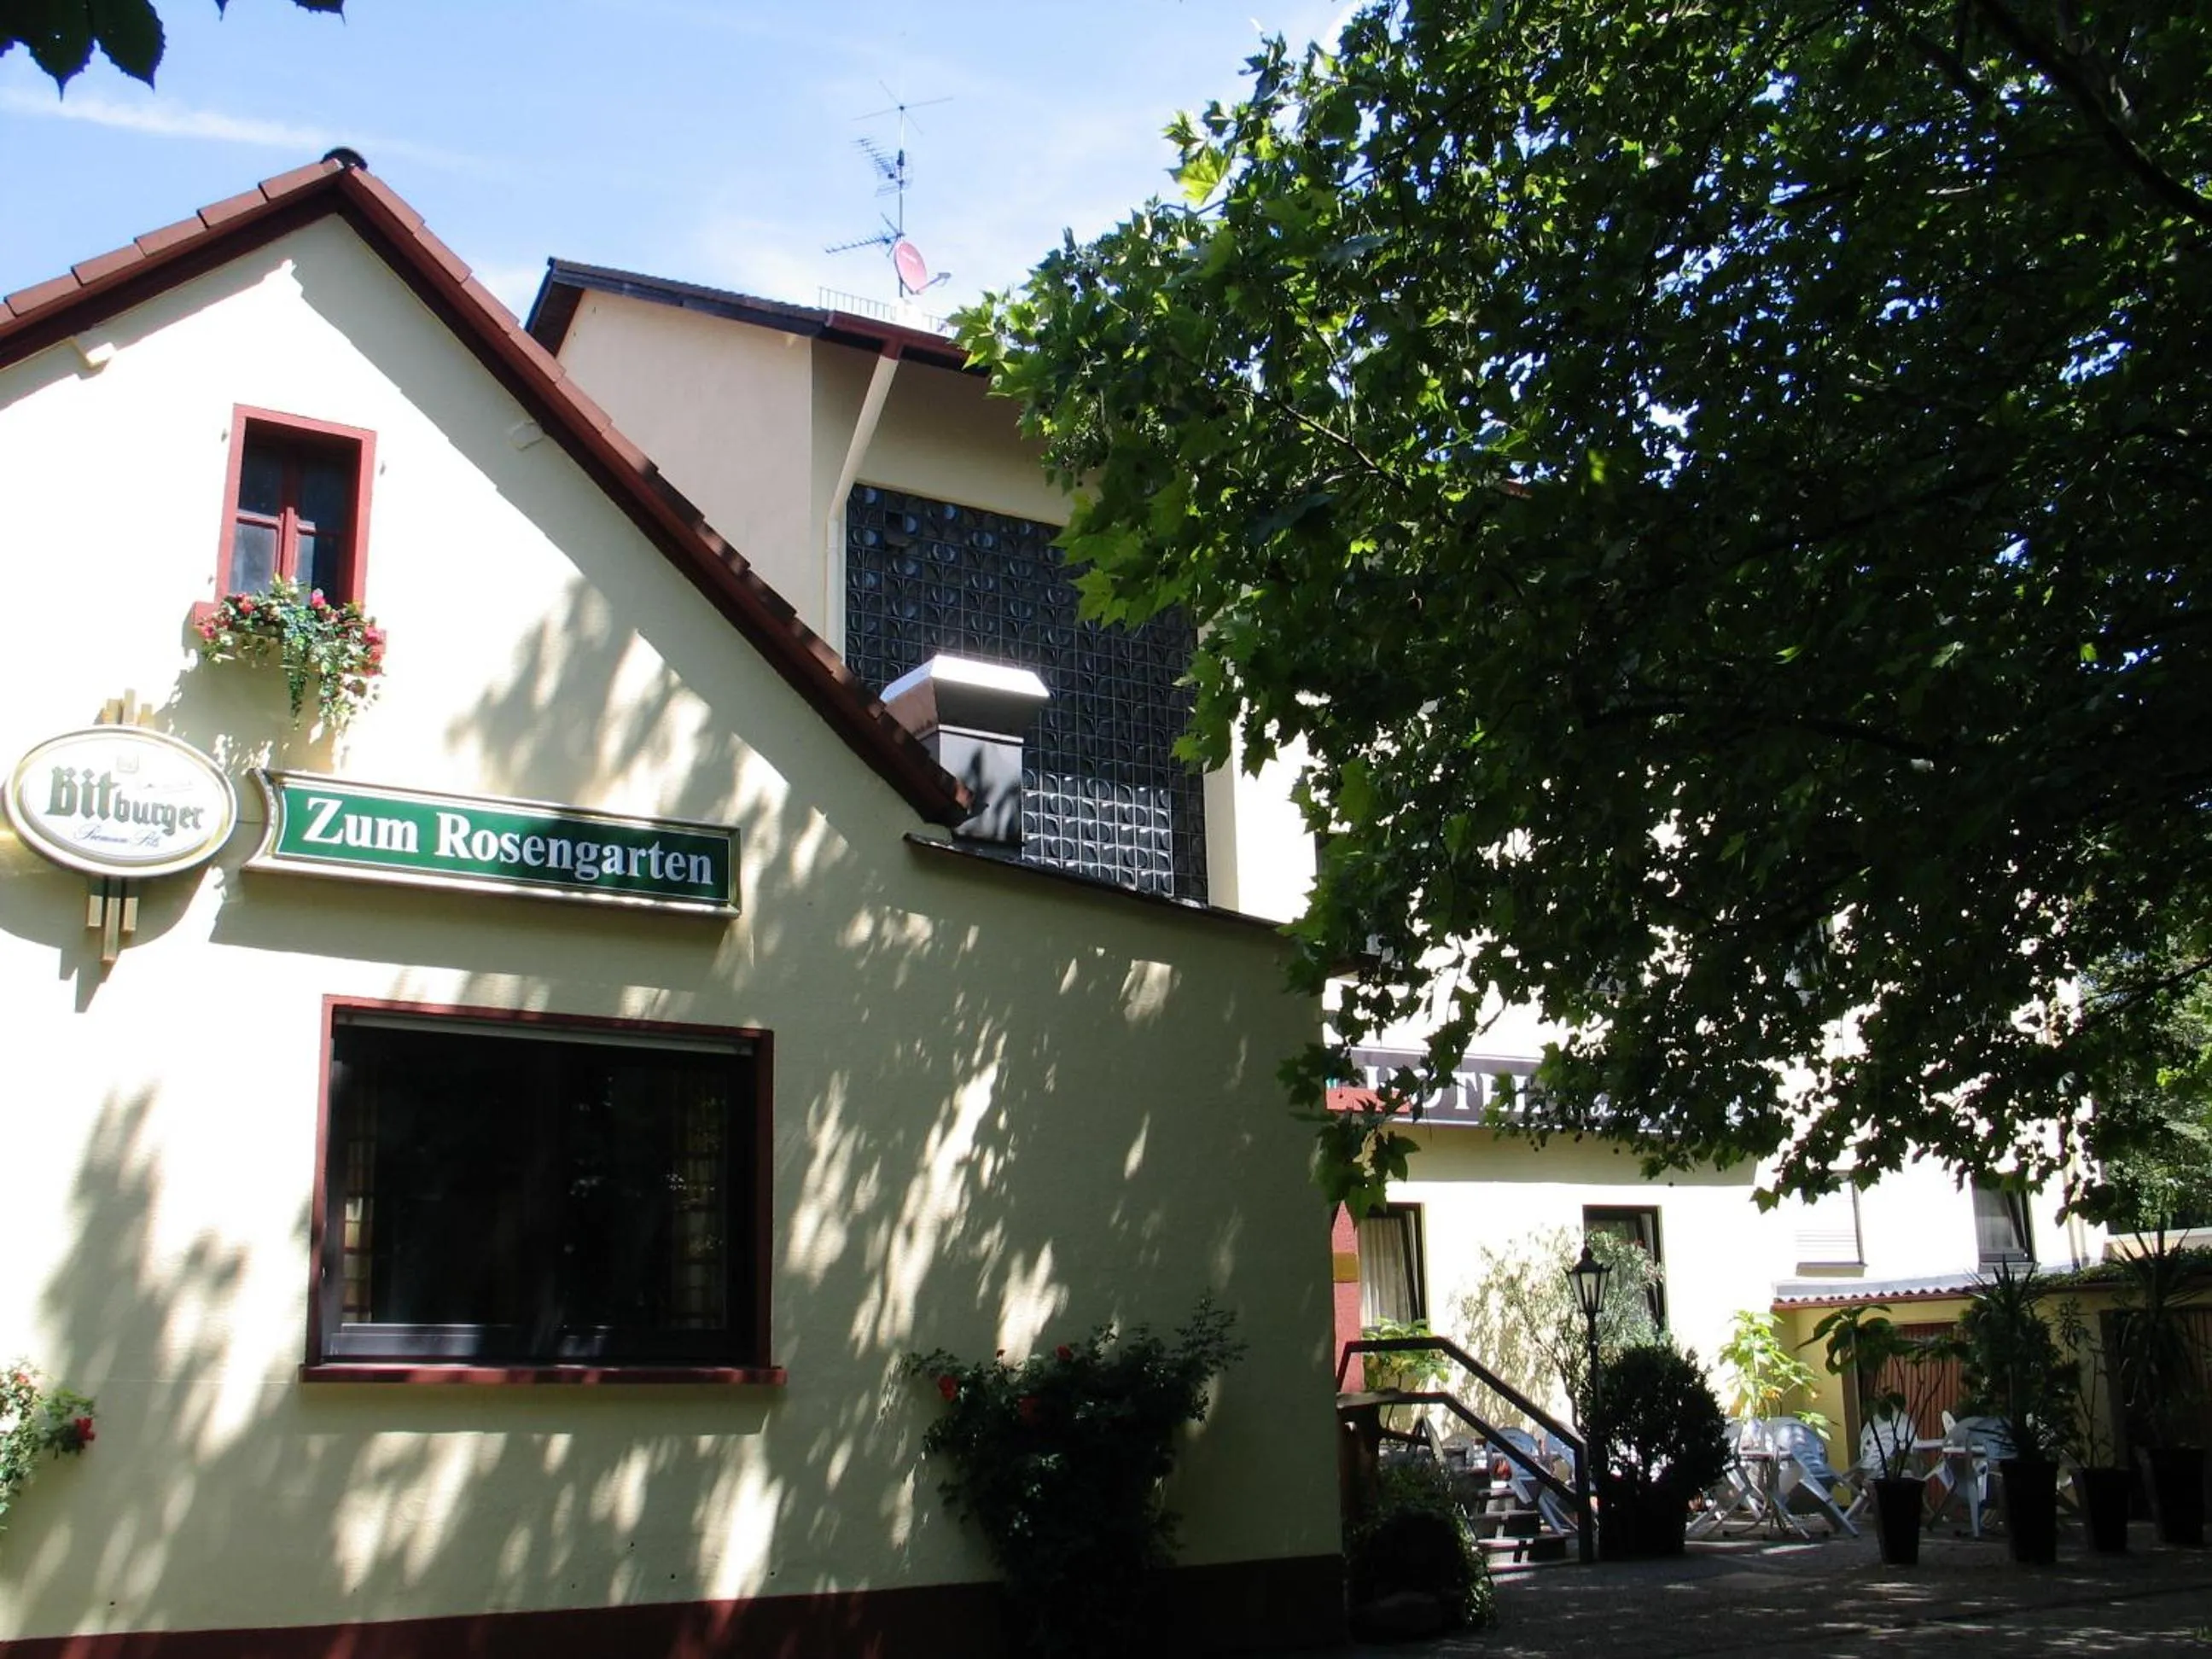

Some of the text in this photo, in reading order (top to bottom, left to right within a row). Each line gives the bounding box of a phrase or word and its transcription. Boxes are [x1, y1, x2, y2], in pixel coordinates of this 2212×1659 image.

[44, 765, 206, 836] Bitburger
[303, 796, 714, 886] Zum Rosengarten
